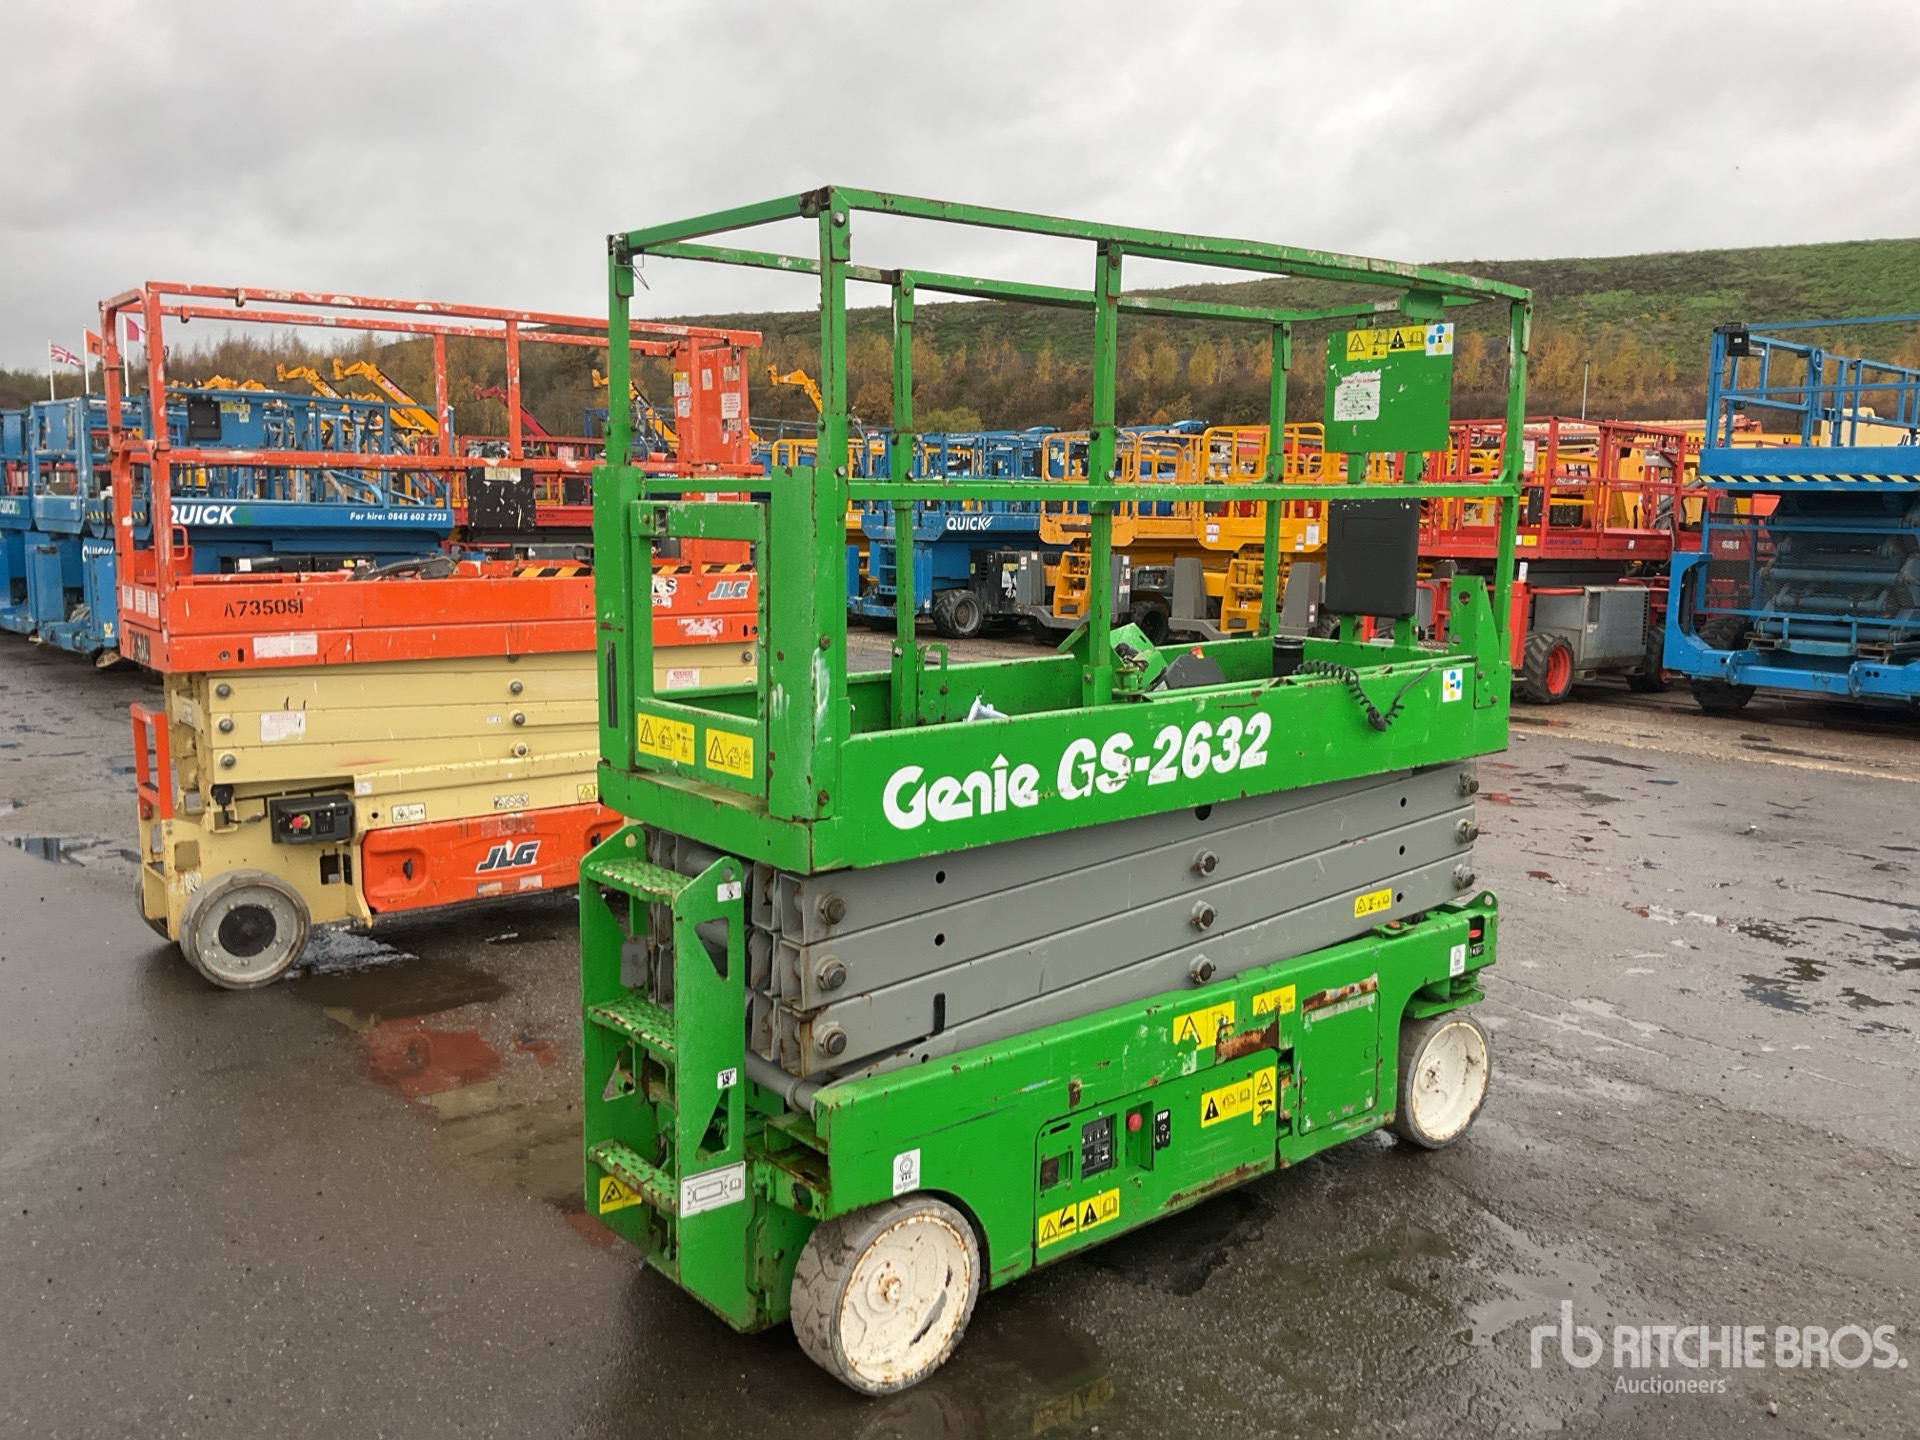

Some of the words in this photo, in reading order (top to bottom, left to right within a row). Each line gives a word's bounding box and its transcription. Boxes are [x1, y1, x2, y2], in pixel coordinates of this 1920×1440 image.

[350, 511, 364, 520] For
[366, 511, 386, 520] hire:
[388, 512, 408, 521] 0845
[410, 512, 425, 521] 602
[427, 513, 447, 521] 2733
[946, 517, 986, 530] QUICK
[708, 581, 750, 600] JLG
[883, 753, 1040, 829] Genie
[1057, 712, 1272, 801] GS-2632
[476, 840, 541, 873] JLG
